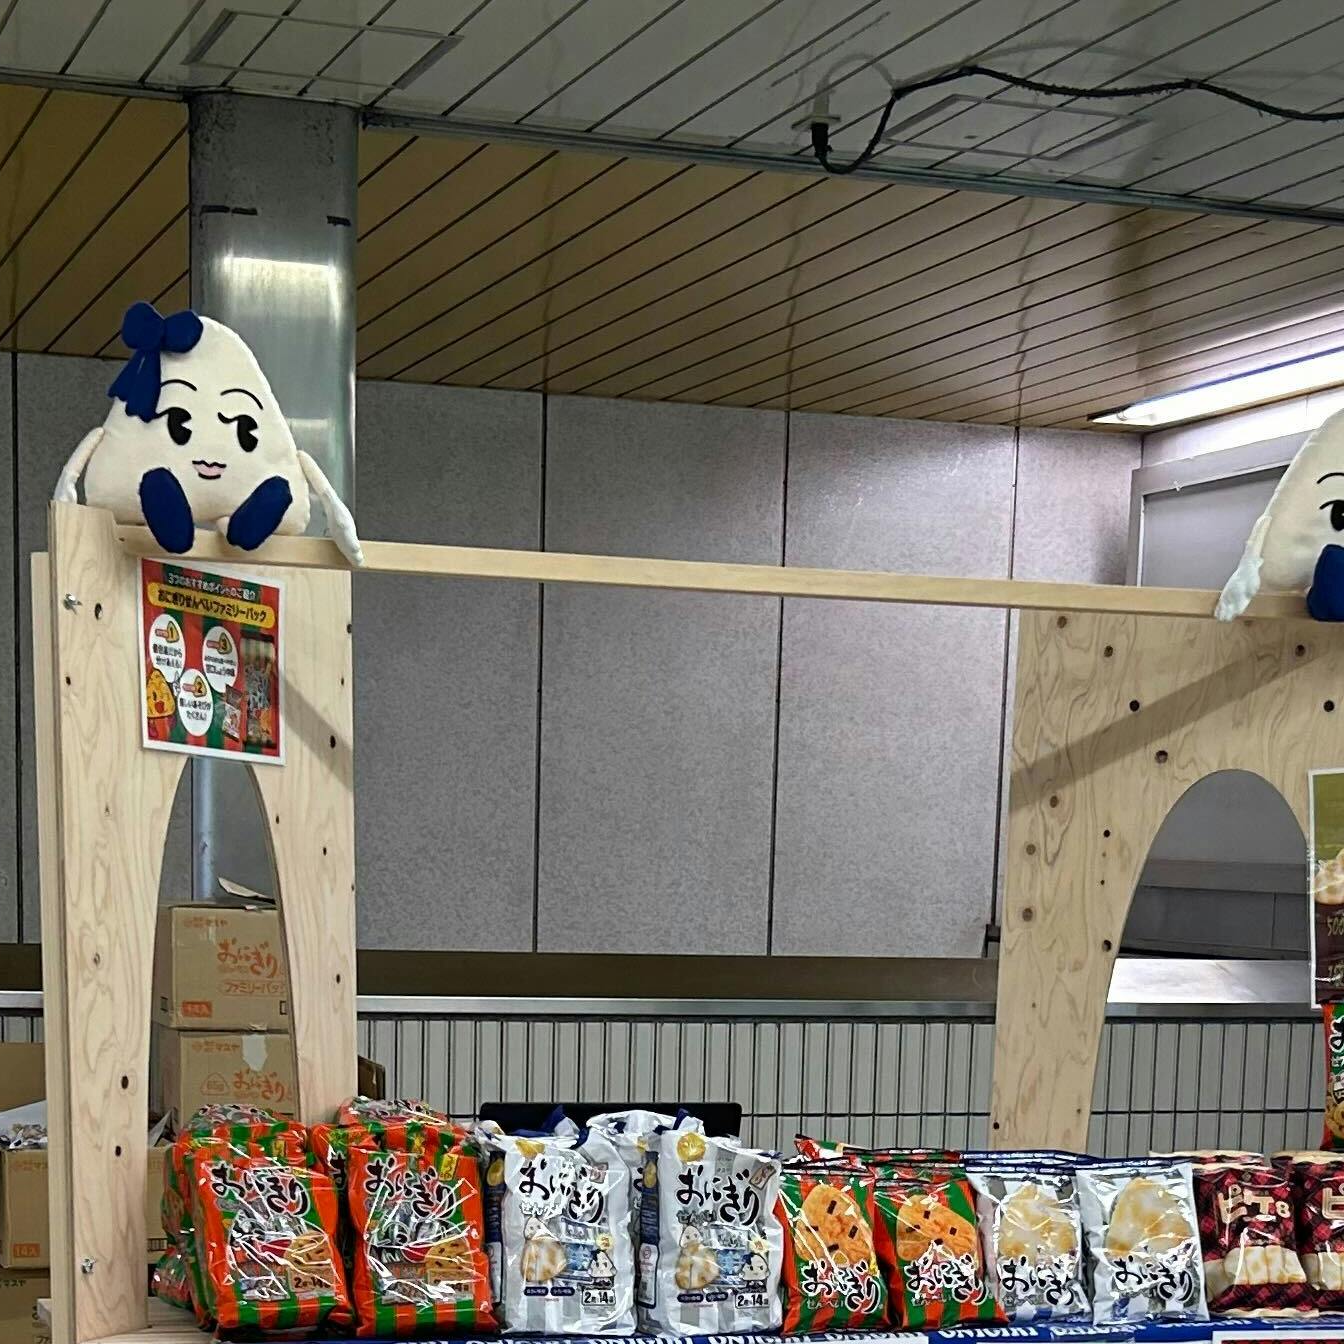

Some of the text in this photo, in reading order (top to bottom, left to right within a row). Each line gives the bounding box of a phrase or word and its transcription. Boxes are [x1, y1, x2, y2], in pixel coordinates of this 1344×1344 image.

[216, 937, 279, 978] おにぎり
[233, 1068, 286, 1103] おにぎり
[210, 1160, 312, 1219] おにぎり
[364, 1155, 457, 1220] おにぎり
[518, 1157, 605, 1224] おにぎり
[676, 1165, 762, 1226] おにぎり
[801, 1259, 881, 1314] おにぎり
[903, 1252, 989, 1306] おにぎり
[1113, 1242, 1194, 1303] おにぎり
